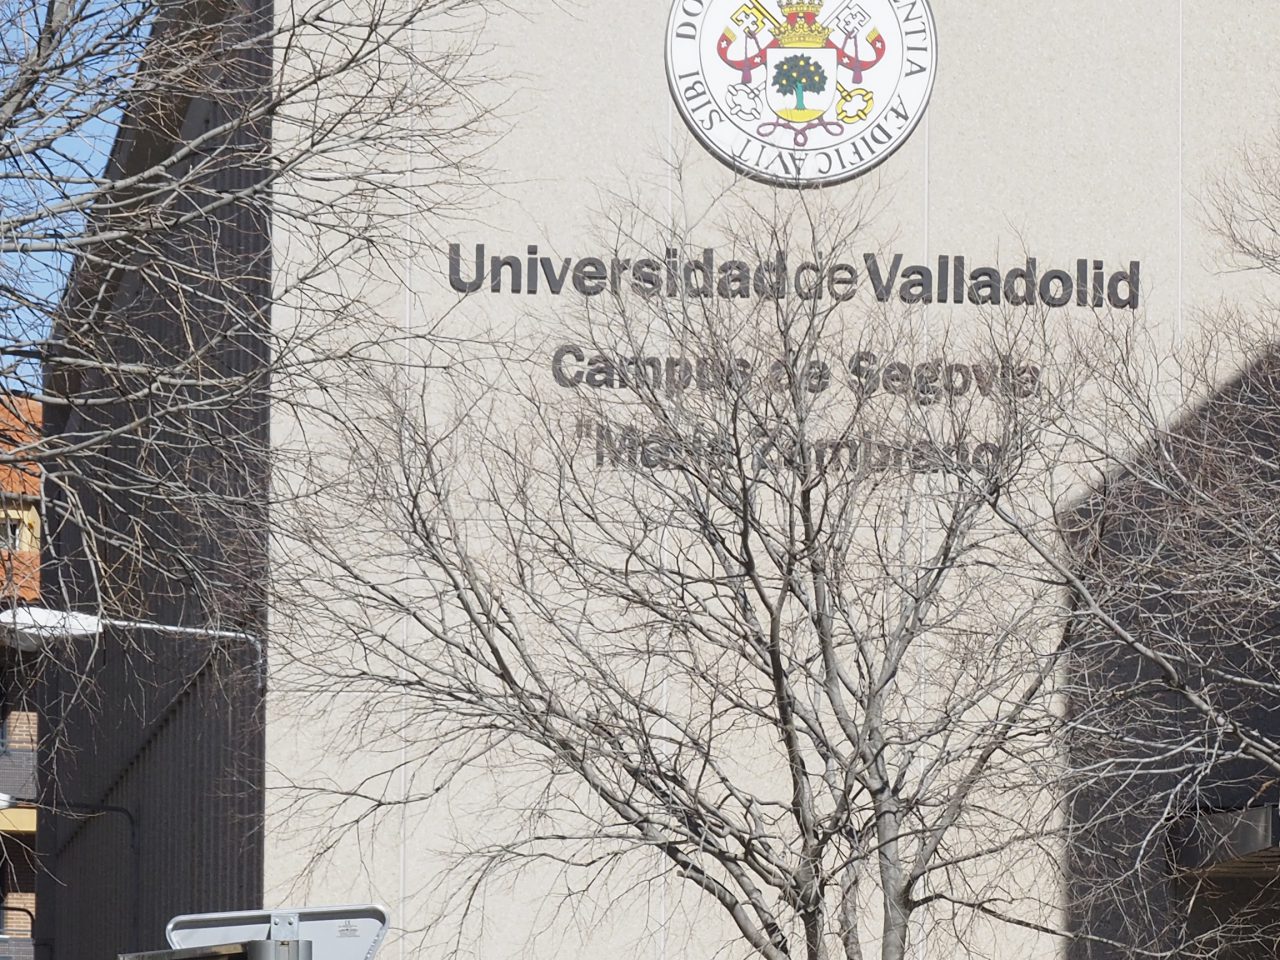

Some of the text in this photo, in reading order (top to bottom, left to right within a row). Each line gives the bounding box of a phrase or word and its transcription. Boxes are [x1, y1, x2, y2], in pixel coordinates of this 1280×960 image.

[678, 70, 725, 132] SIBI
[449, 242, 1140, 309] Universidad de Valladolid
[551, 344, 752, 396] Campus
[851, 350, 1042, 406] Segovia
